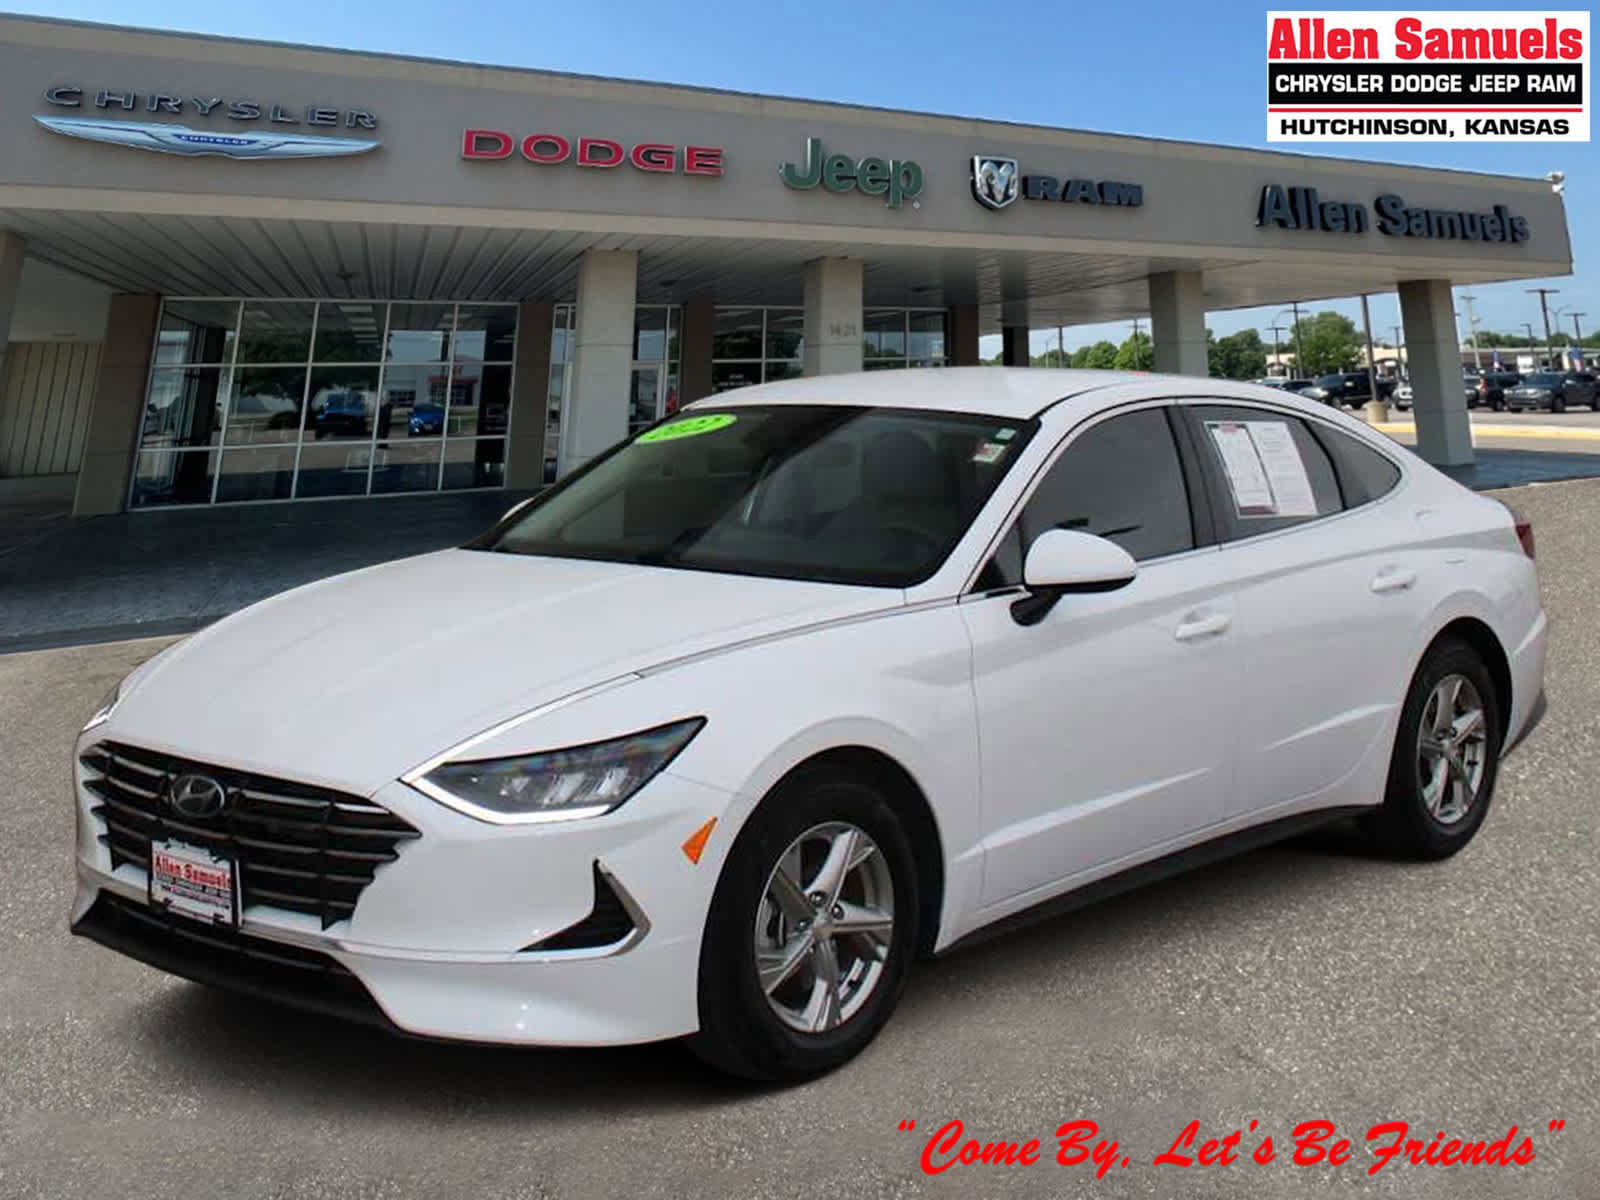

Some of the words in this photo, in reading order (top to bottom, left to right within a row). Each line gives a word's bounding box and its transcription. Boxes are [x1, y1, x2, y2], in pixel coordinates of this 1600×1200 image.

[43, 86, 378, 130] CHRYSLER
[461, 128, 725, 177] DODGE
[779, 136, 924, 210] Jeep
[1022, 174, 1145, 208] RAM
[1257, 184, 1368, 233] Allen
[1374, 194, 1529, 243] Samuels
[154, 854, 182, 876] Allen
